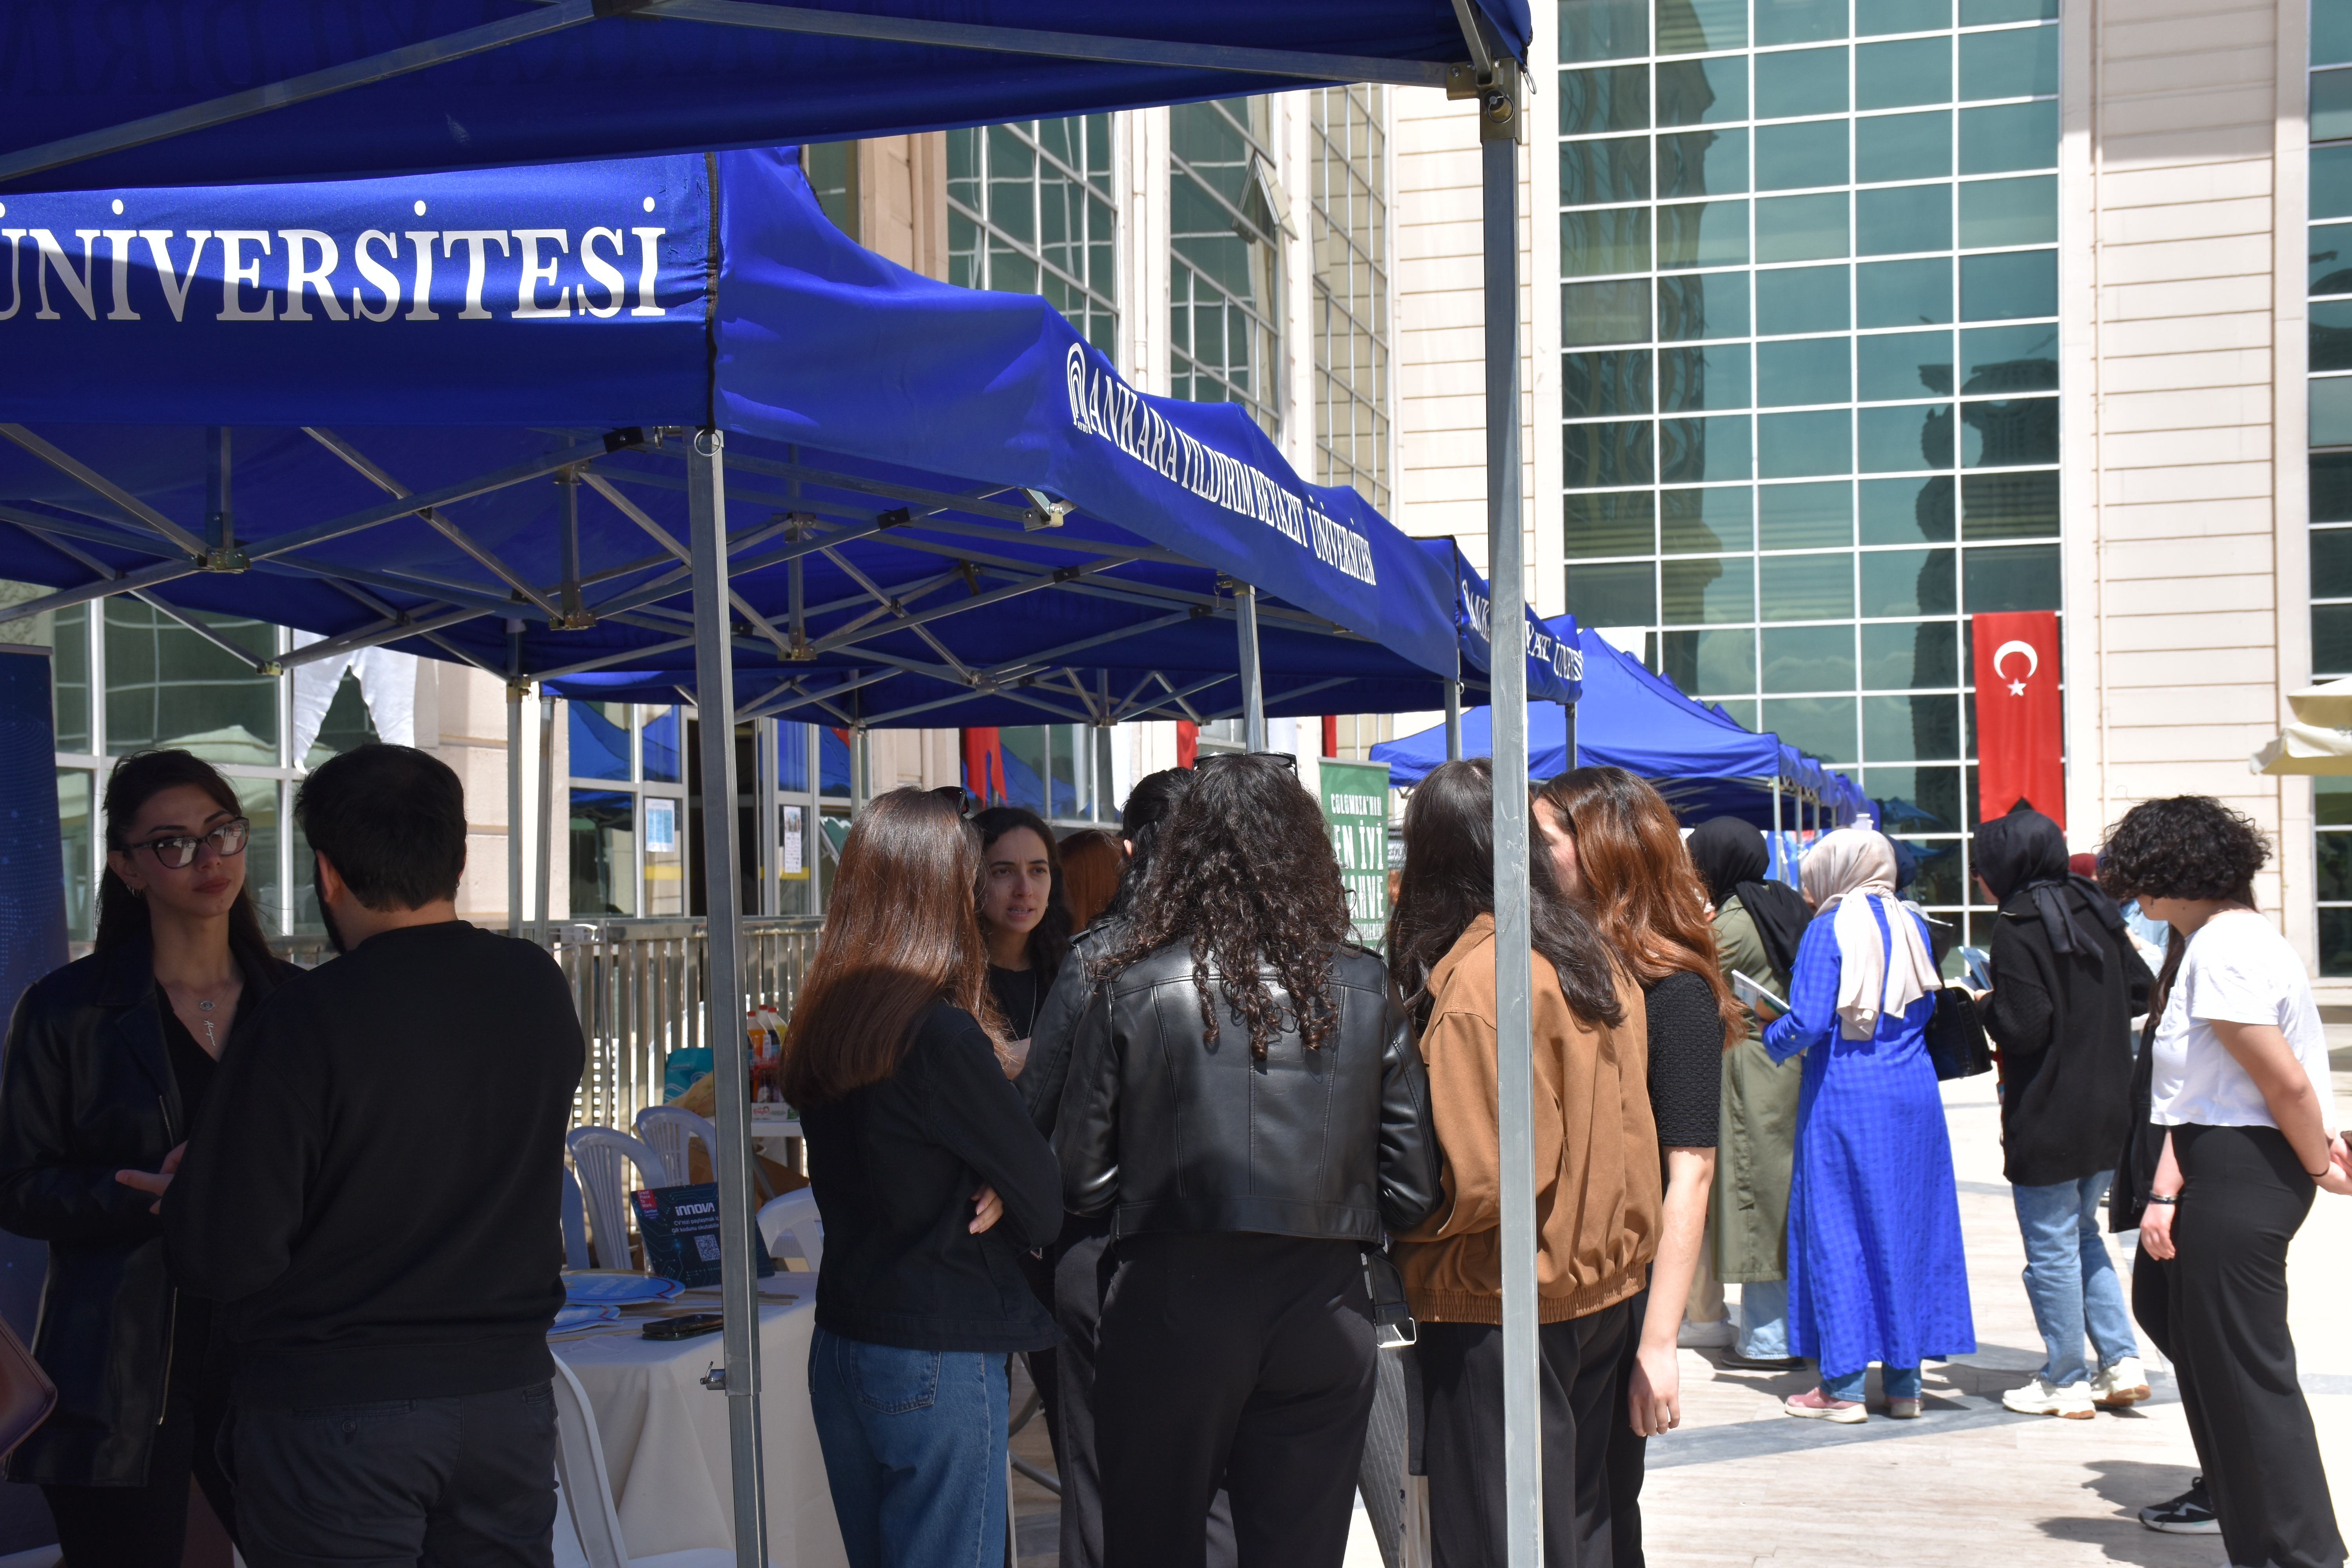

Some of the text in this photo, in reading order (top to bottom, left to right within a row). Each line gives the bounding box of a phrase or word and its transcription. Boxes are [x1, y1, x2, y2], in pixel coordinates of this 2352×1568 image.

[1089, 368, 1376, 586] ANKARA YILDIRIM BEYAZIT ÜNİVERSİTESİ
[1334, 819, 1384, 870] EN İYİ
[1341, 875, 1384, 919] AHVE
